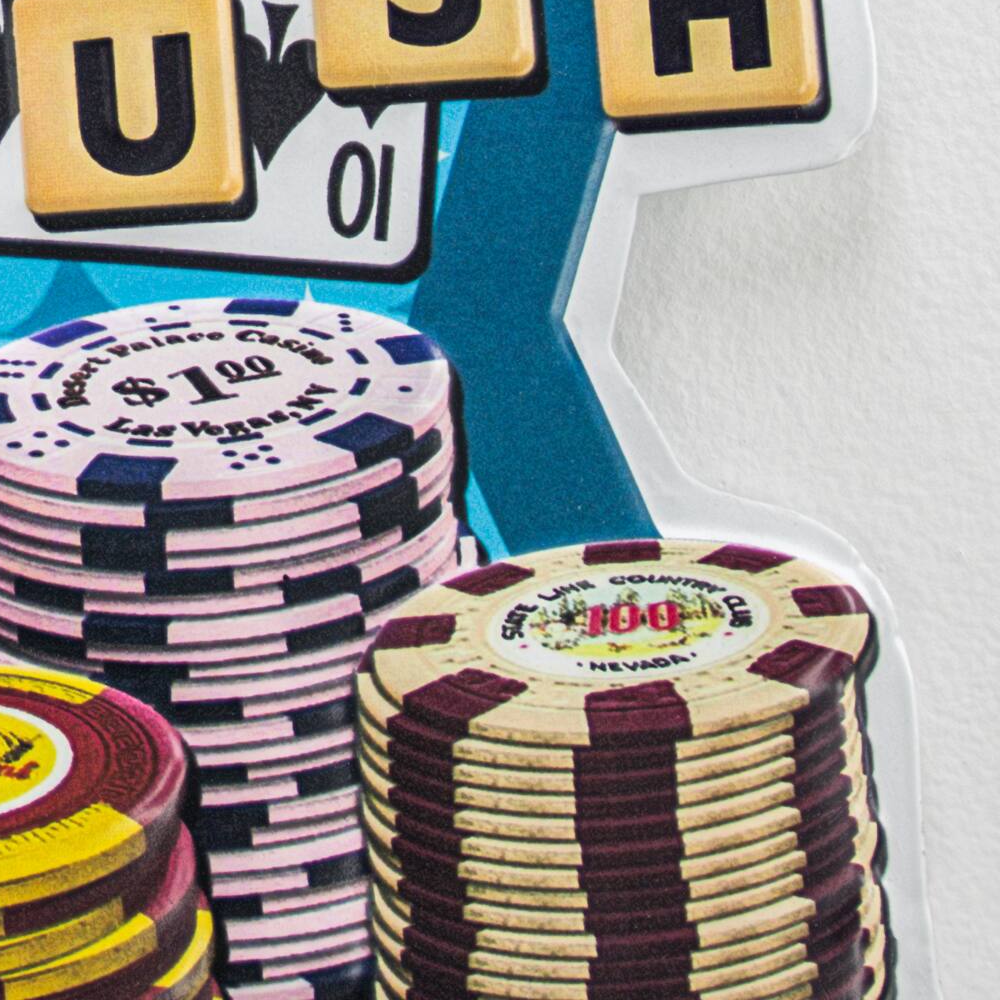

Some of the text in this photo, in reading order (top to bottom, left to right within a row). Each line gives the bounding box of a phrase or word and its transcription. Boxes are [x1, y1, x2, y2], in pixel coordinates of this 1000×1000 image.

[106, 331, 225, 358] Palace
[235, 329, 334, 365] Casino
[103, 417, 178, 438] Las
[608, 574, 727, 594] COUNTRY
[584, 601, 682, 637] 100
[588, 654, 691, 673] NEVADA
